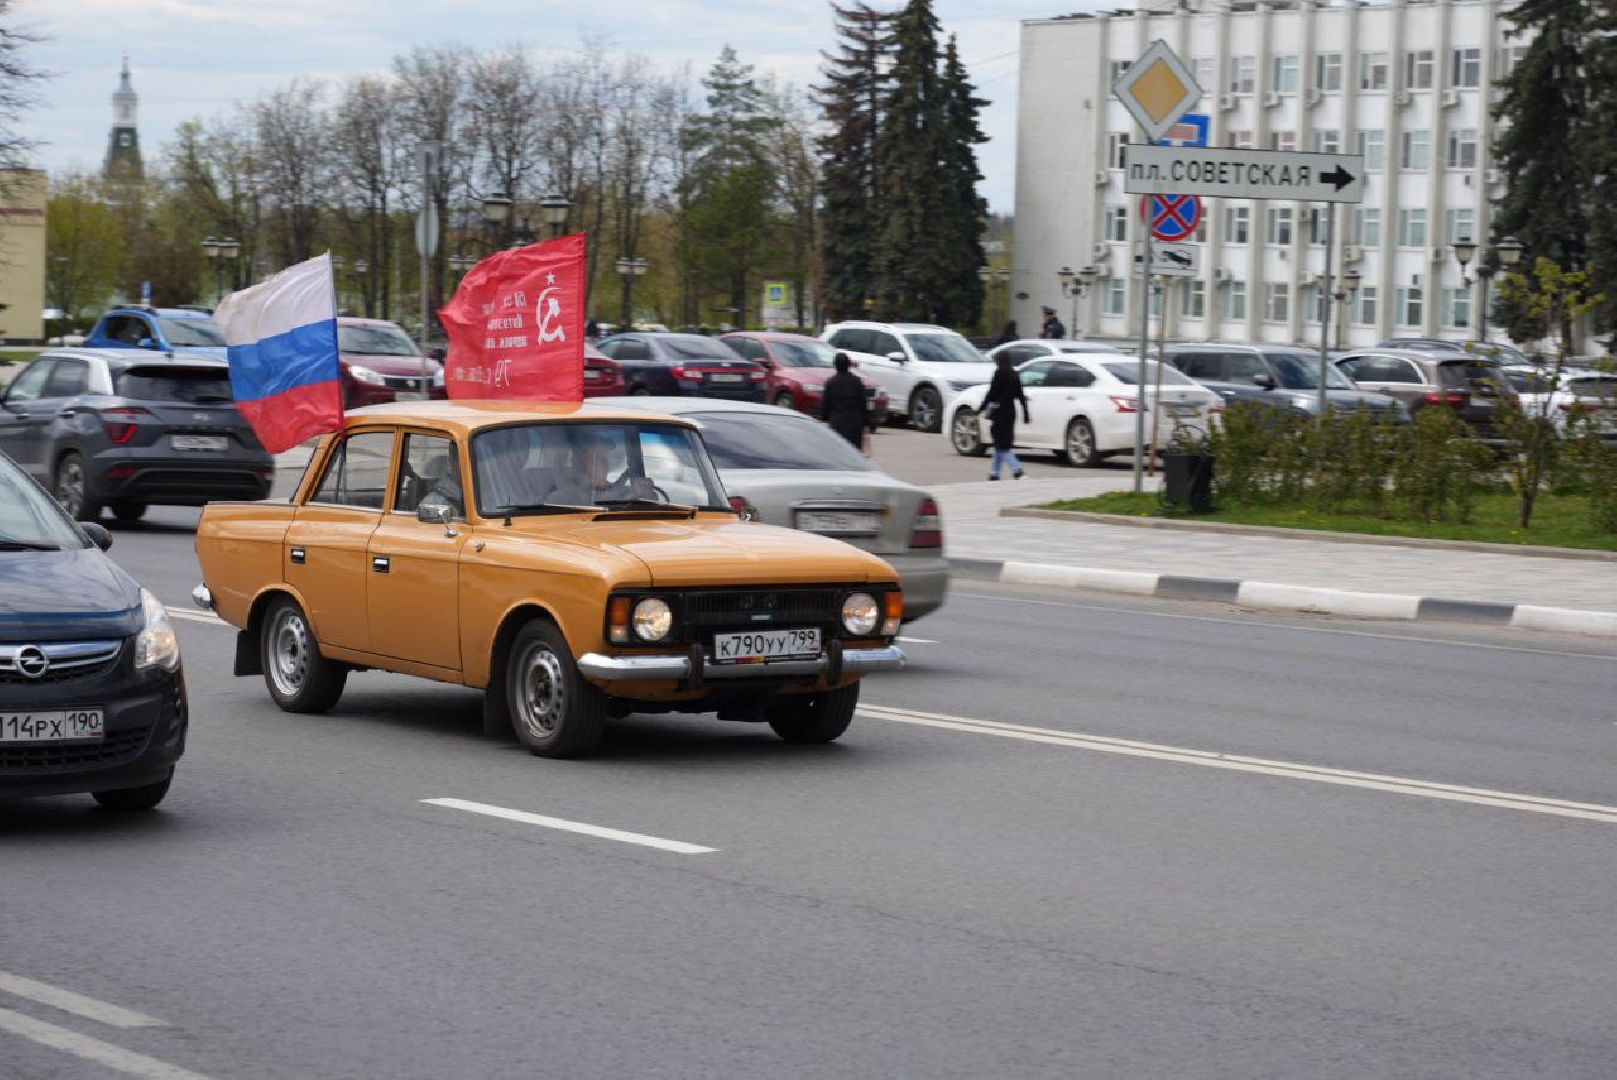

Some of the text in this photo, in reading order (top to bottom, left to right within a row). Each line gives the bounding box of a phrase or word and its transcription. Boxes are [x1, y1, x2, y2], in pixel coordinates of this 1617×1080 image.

[1171, 159, 1311, 187] СОВЕТСКАЯ
[789, 630, 815, 646] 799
[68, 712, 99, 731] 190
